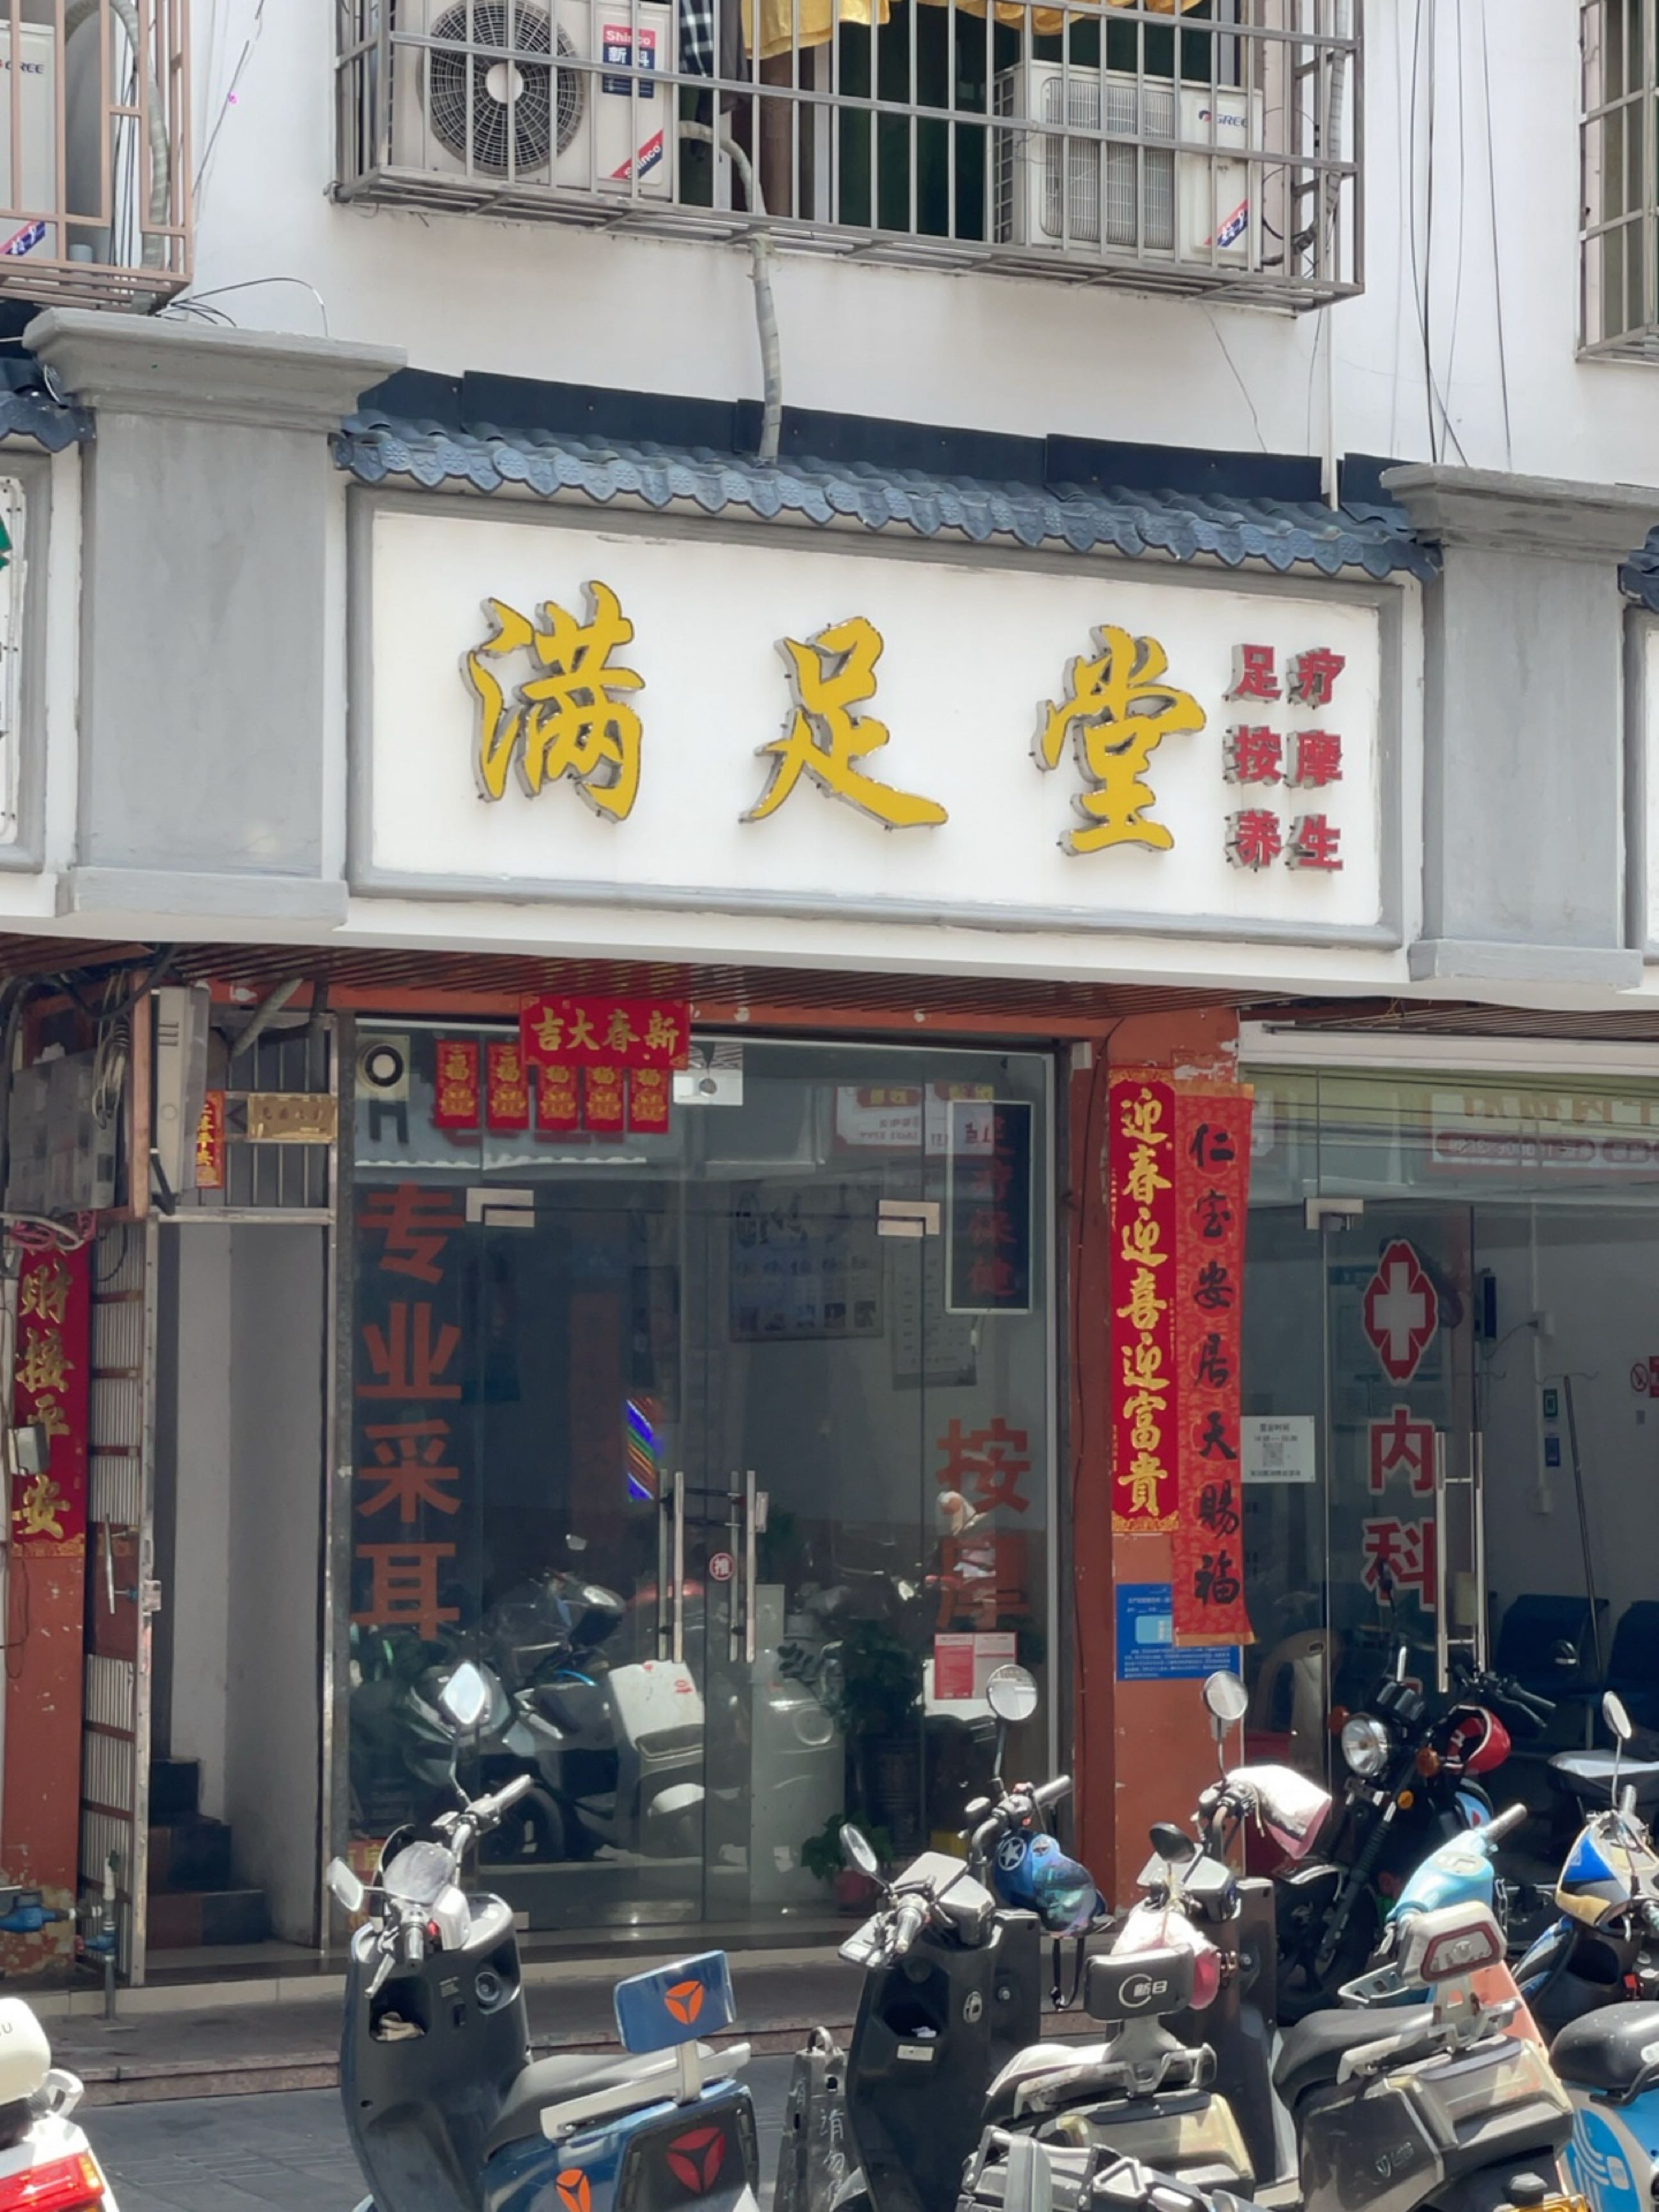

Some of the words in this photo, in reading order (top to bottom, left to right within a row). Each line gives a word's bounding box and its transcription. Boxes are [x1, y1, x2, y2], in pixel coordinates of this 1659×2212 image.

[460, 580, 1207, 856] 满足堂
[1222, 644, 1346, 709] 足疗
[1222, 725, 1343, 789] 按摩
[1224, 808, 1344, 872] 养生
[351, 1179, 466, 1642] 专业采耳
[1364, 1406, 1436, 1610] 内科
